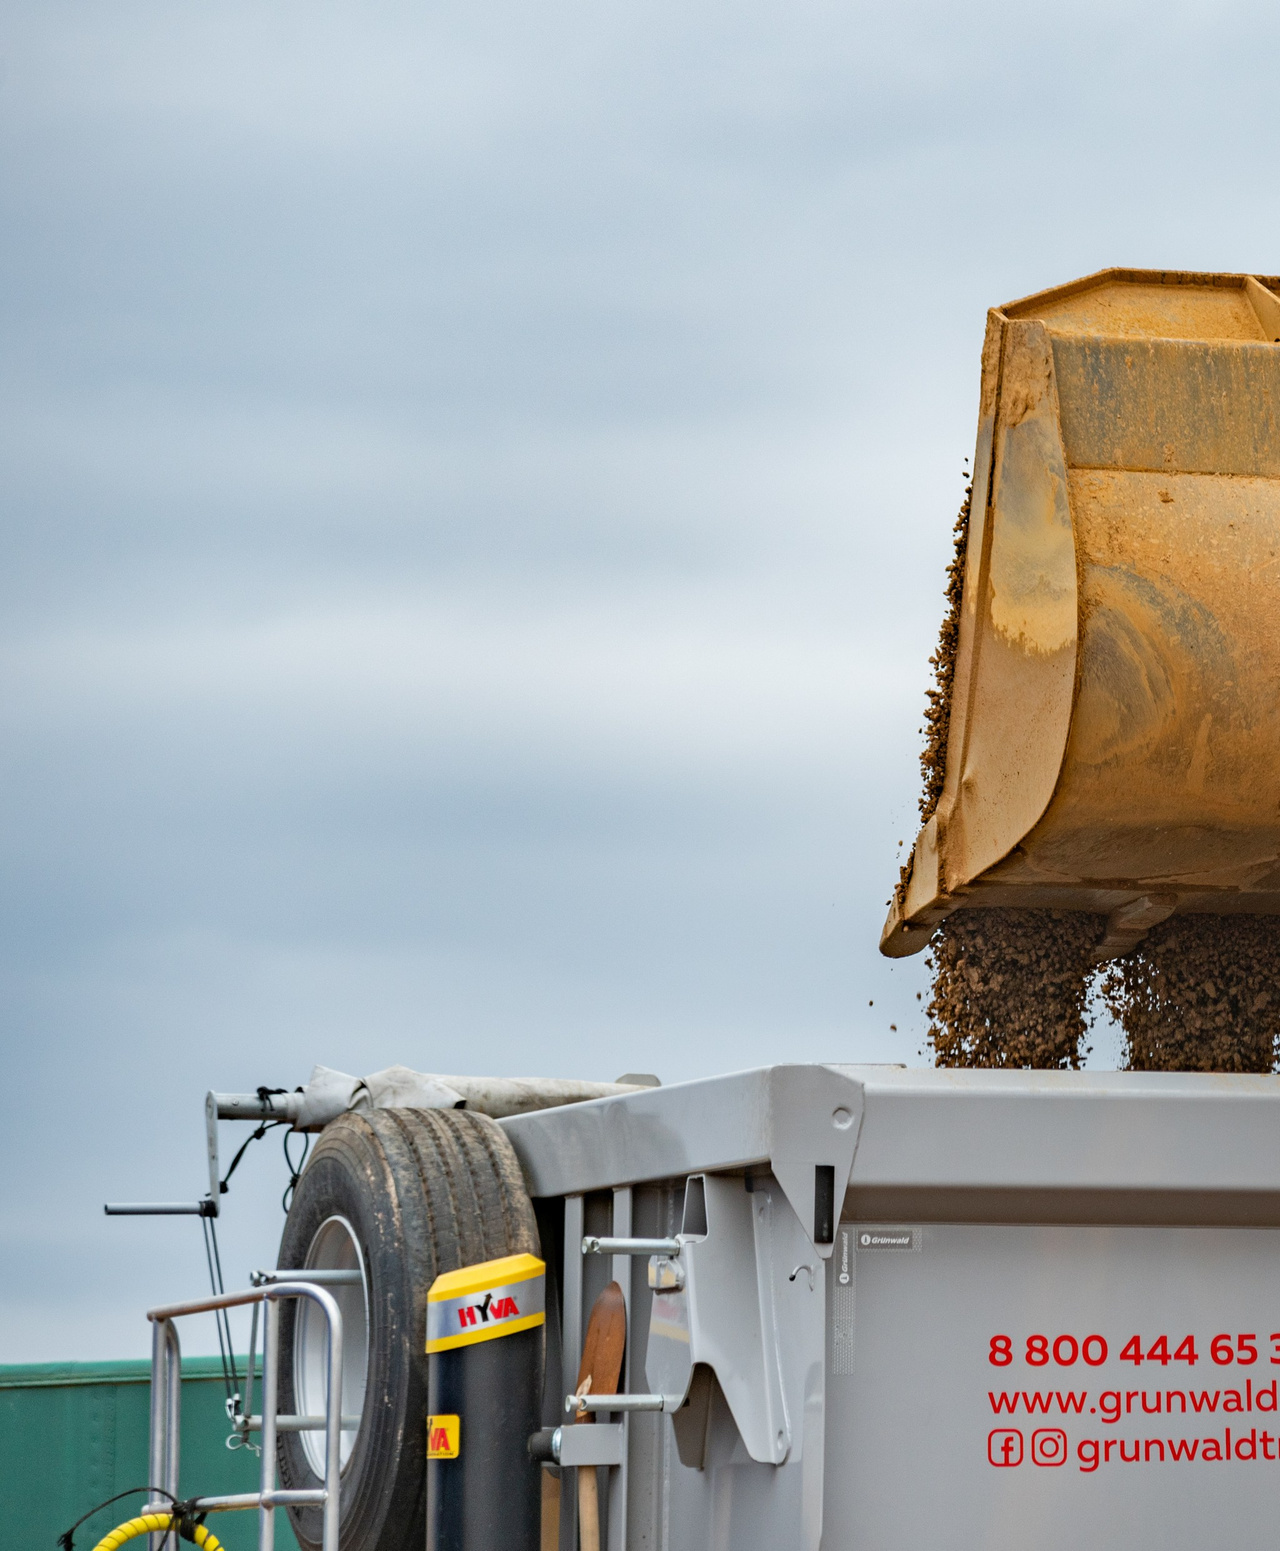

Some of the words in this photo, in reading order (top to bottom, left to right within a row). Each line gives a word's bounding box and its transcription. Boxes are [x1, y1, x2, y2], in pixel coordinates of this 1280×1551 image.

[458, 1293, 519, 1328] HYVA
[989, 1334, 1013, 1367] 8
[1025, 1334, 1108, 1367] 800
[1120, 1335, 1199, 1366] 444
[1210, 1333, 1258, 1366] 65
